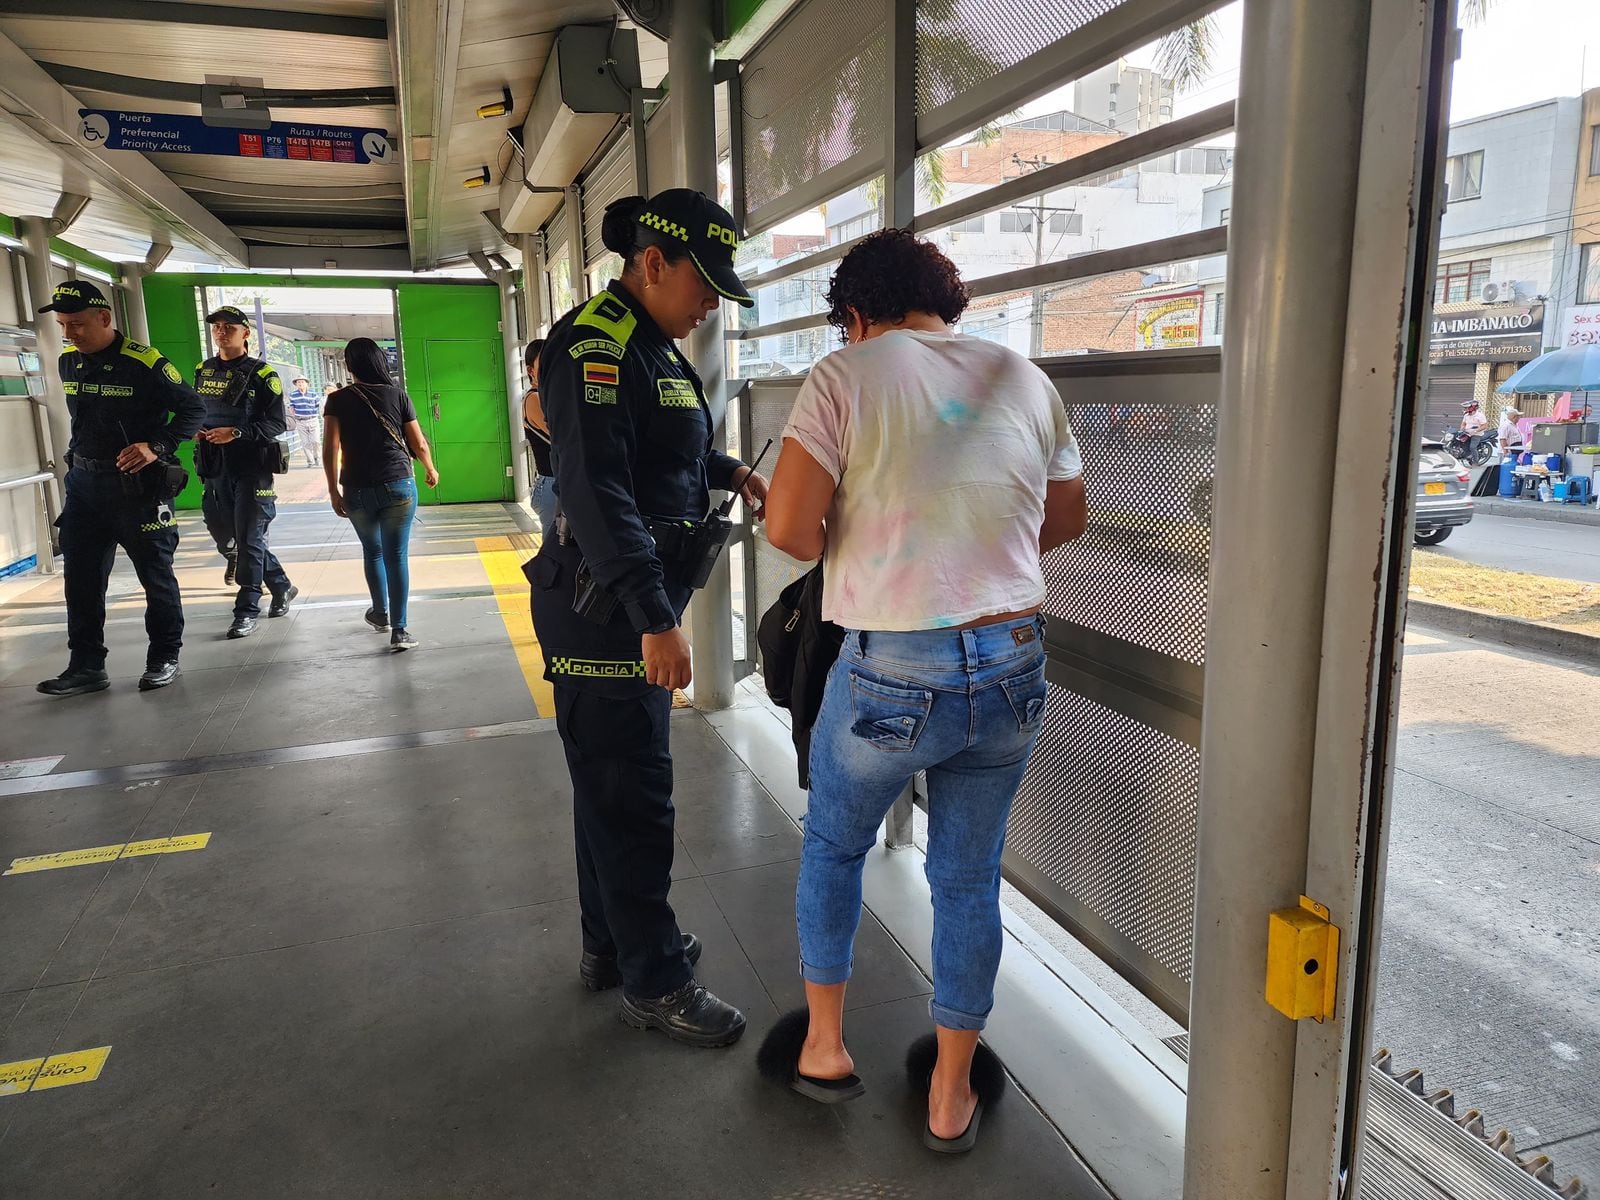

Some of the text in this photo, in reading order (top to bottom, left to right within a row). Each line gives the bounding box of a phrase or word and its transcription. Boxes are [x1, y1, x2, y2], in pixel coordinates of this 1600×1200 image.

[119, 113, 152, 122] Puerta
[120, 127, 180, 139] Preferencial
[290, 127, 315, 136] Rutas
[322, 130, 353, 139] Routes
[121, 138, 192, 152] Priority Access
[266, 136, 282, 144] P76
[1451, 314, 1533, 333] IMBANACO
[1574, 315, 1592, 324] Sex
[1457, 340, 1468, 348] Oro
[573, 664, 629, 675] POLICÍA
